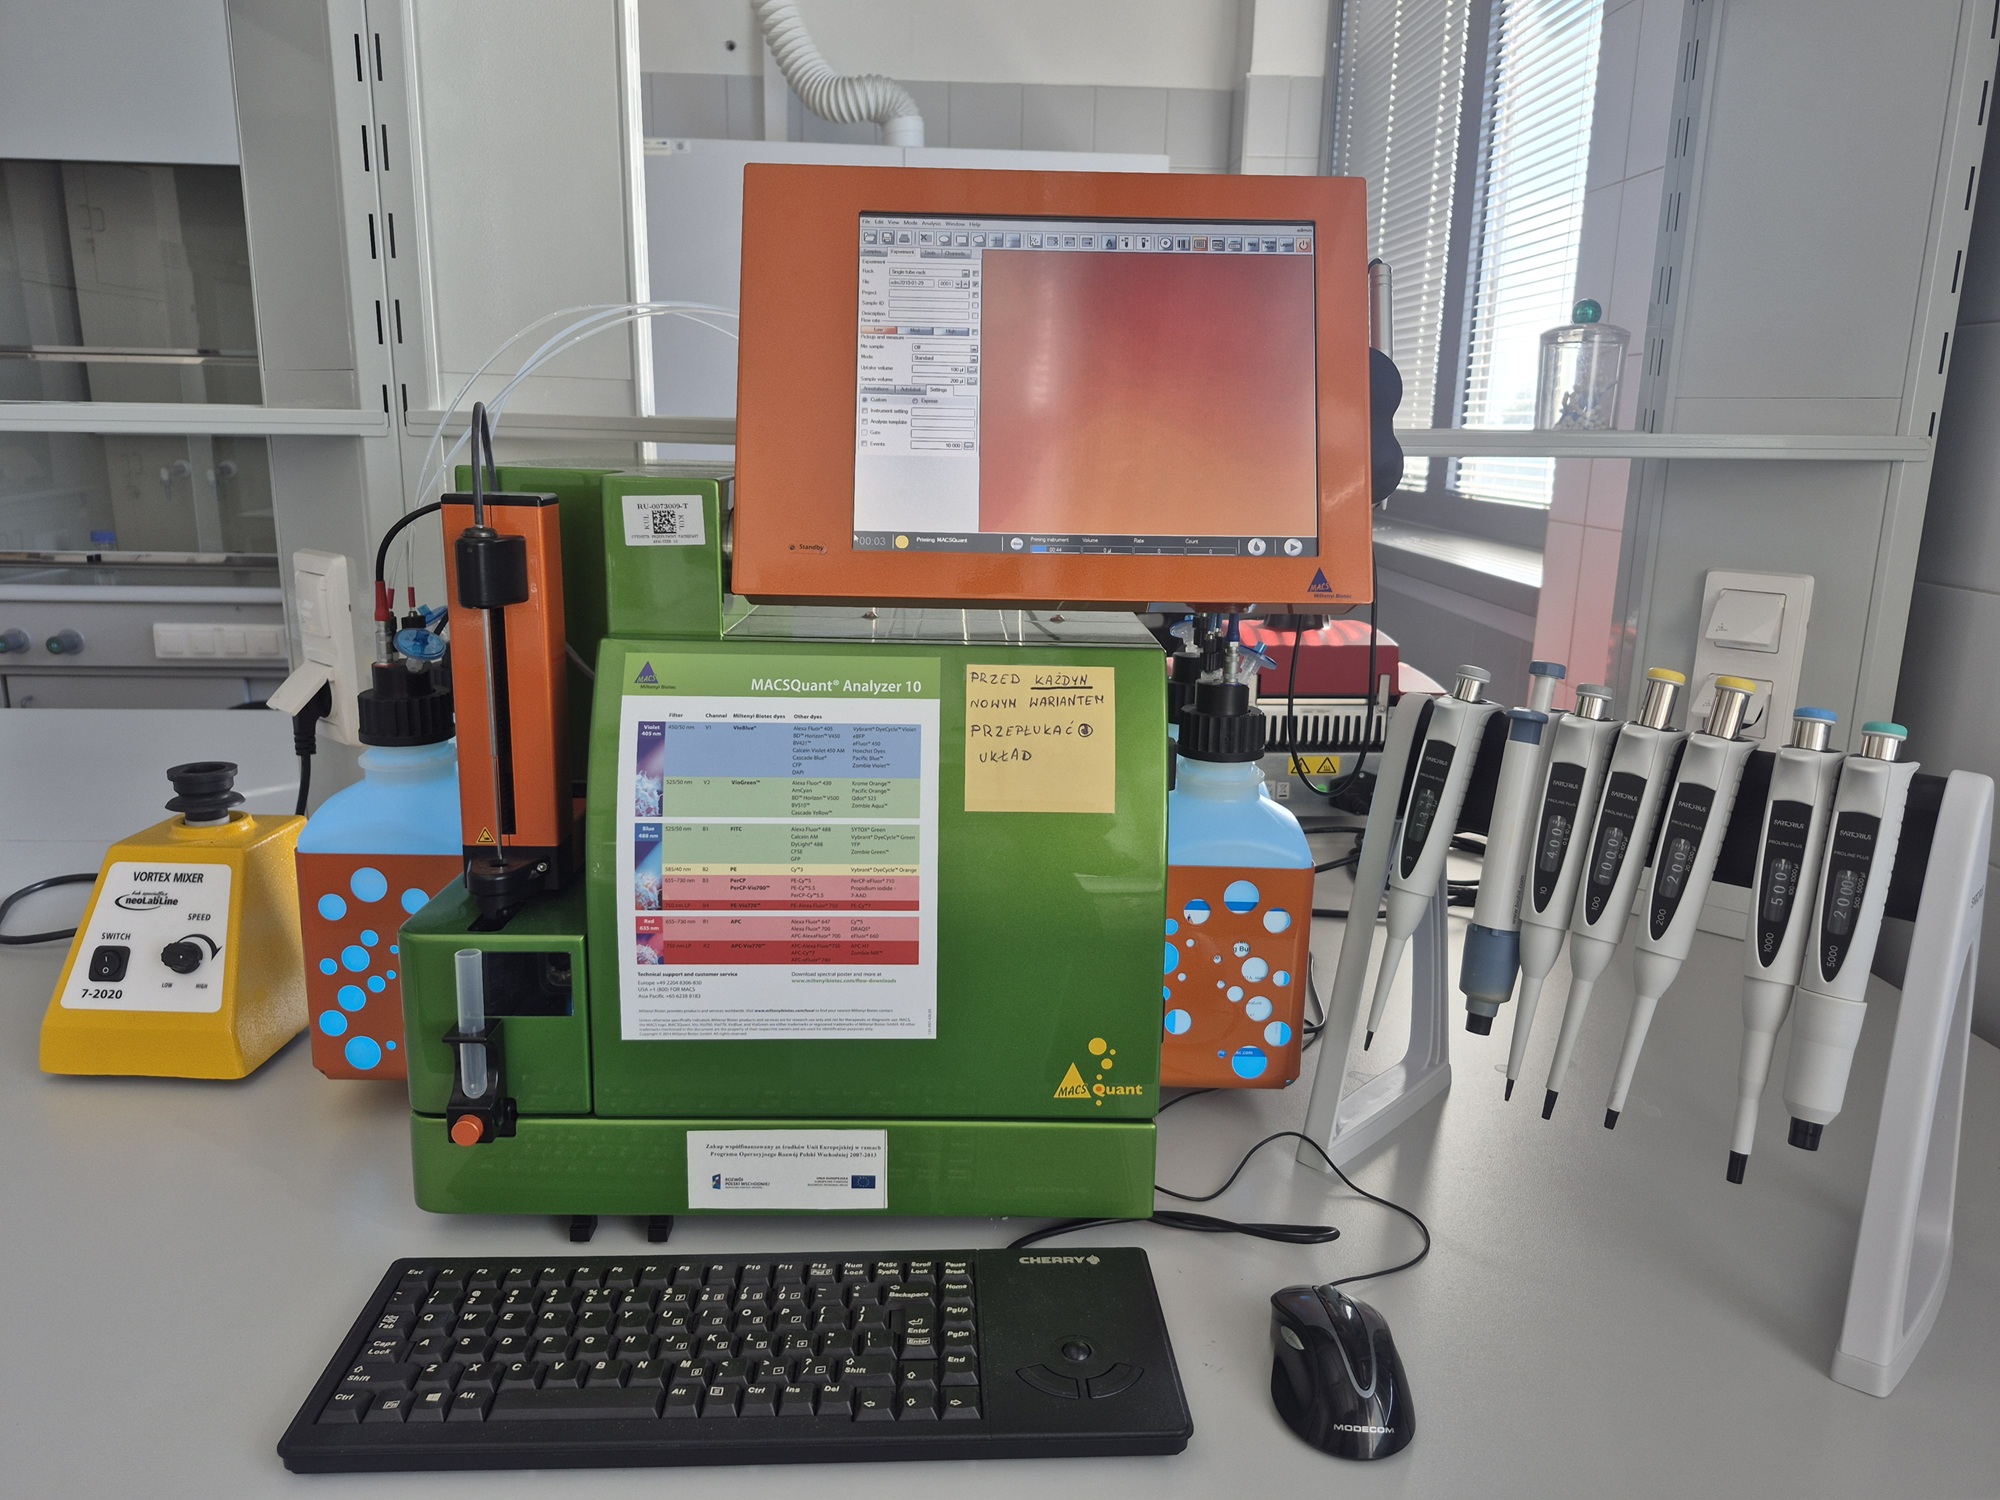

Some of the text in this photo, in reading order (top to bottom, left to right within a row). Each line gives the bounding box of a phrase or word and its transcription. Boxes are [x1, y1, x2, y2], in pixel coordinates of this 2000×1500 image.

[859, 537, 886, 546] 00:03
[799, 544, 824, 552] Standby
[1310, 583, 1329, 591] MACS
[970, 671, 1021, 685] PRZED
[843, 680, 901, 695] Analyzer
[906, 681, 921, 693] 10
[970, 721, 1074, 737] PRZEPŁUKAĆ
[979, 748, 1032, 763] UKŁAD
[133, 872, 203, 883] VORTEX MIXER
[1540, 886, 1548, 895] 10
[125, 896, 178, 905] neoLabLine
[1591, 896, 1600, 910] 100
[1656, 909, 1666, 926] 200
[1764, 933, 1774, 952] 1000
[1827, 946, 1838, 967] 5000
[81, 989, 123, 999] 7-2020
[1058, 1085, 1086, 1096] MACS
[1092, 1083, 1143, 1097] Quant
[1018, 1256, 1085, 1264] CHERRY
[1333, 1424, 1394, 1433] MODECOM
